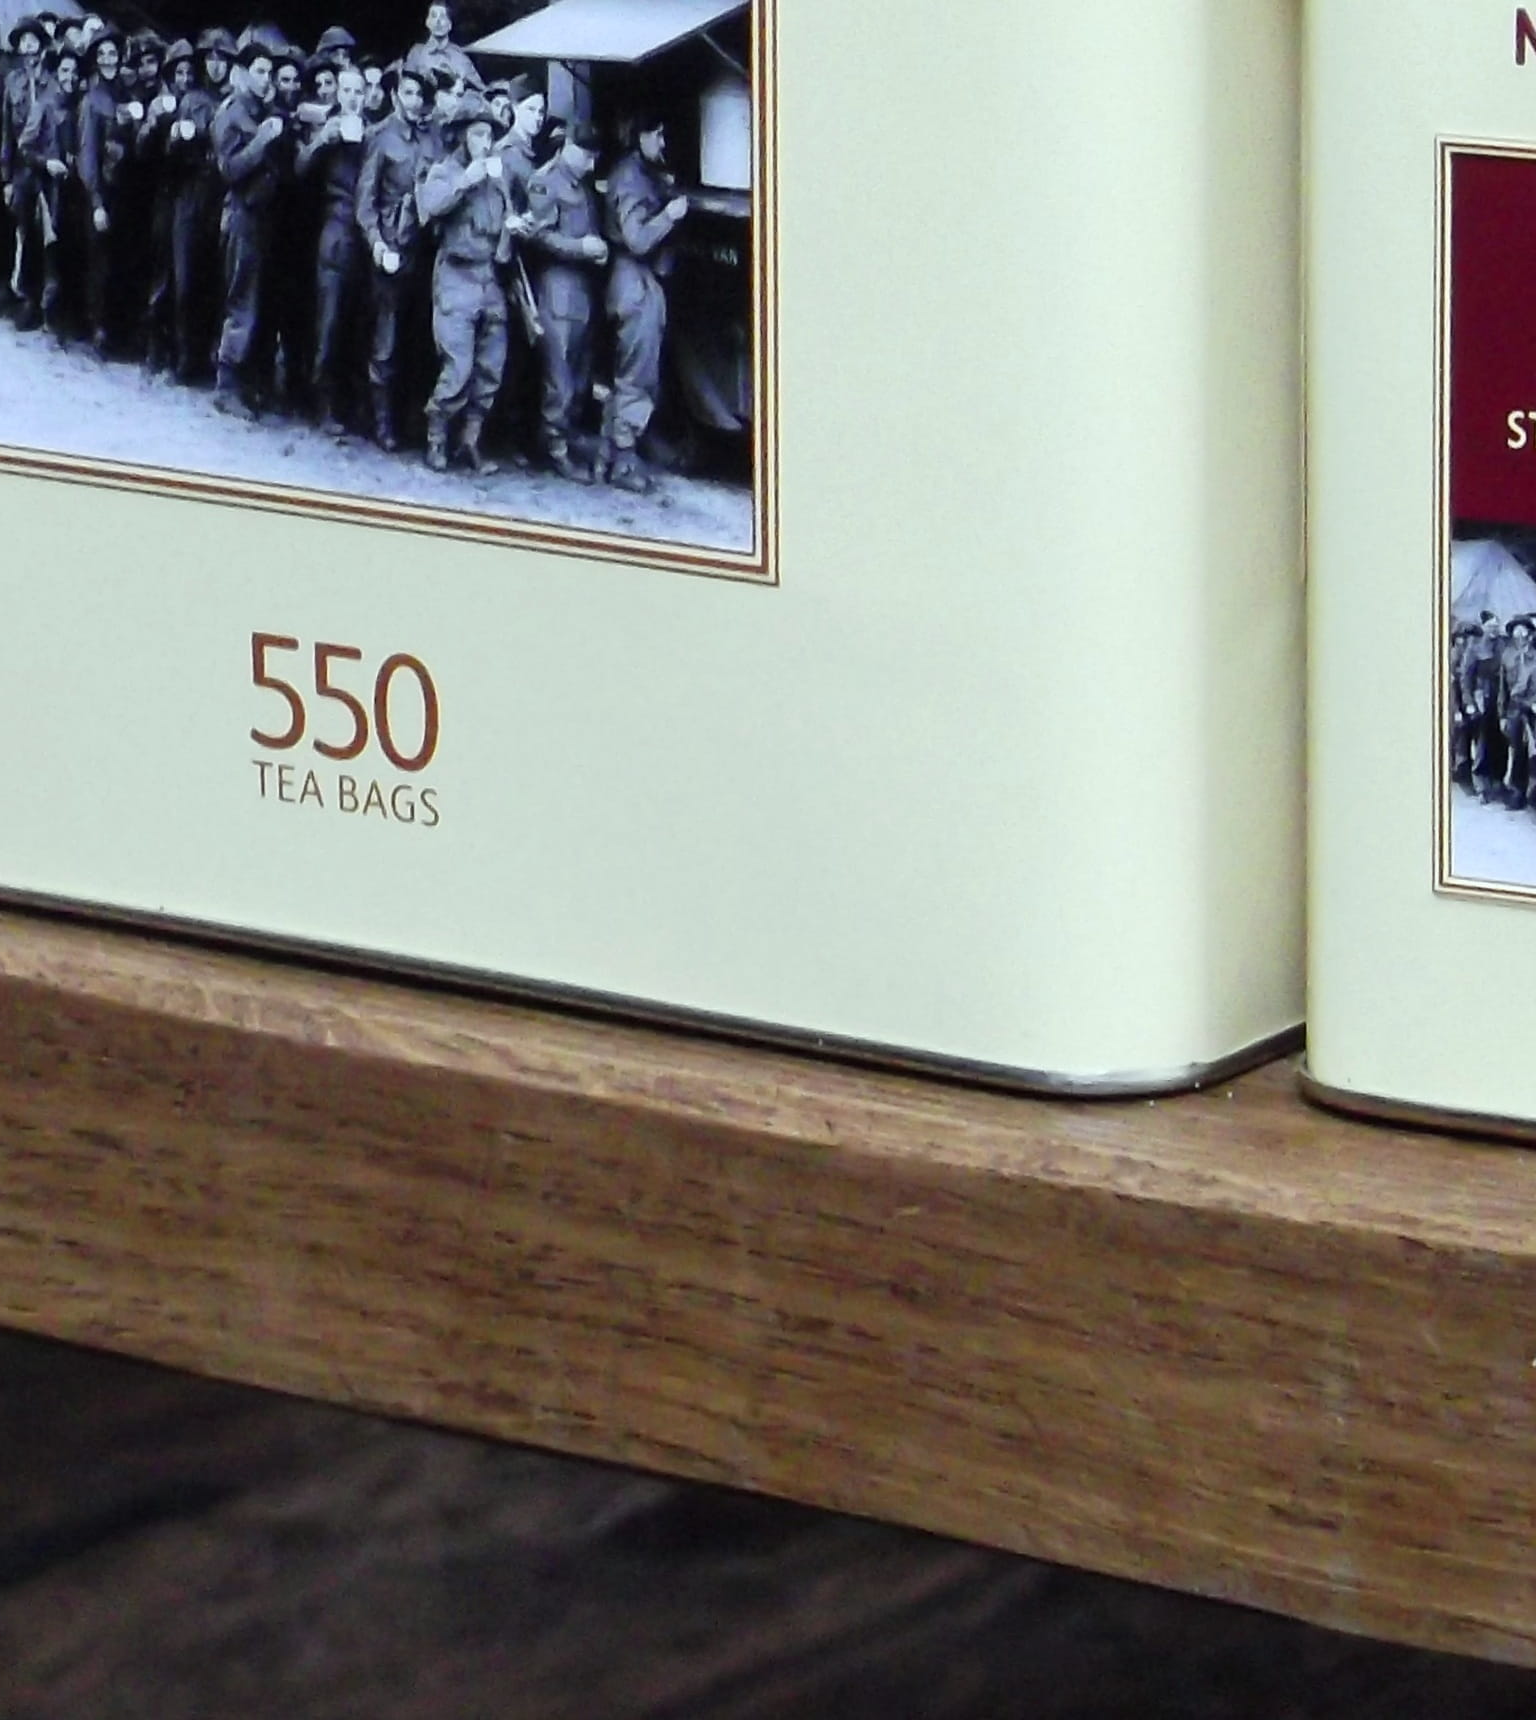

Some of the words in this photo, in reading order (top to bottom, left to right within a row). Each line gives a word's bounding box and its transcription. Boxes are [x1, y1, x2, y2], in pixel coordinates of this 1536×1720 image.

[250, 631, 440, 772] 550
[251, 760, 324, 808] TEA
[338, 774, 440, 827] BAGS
